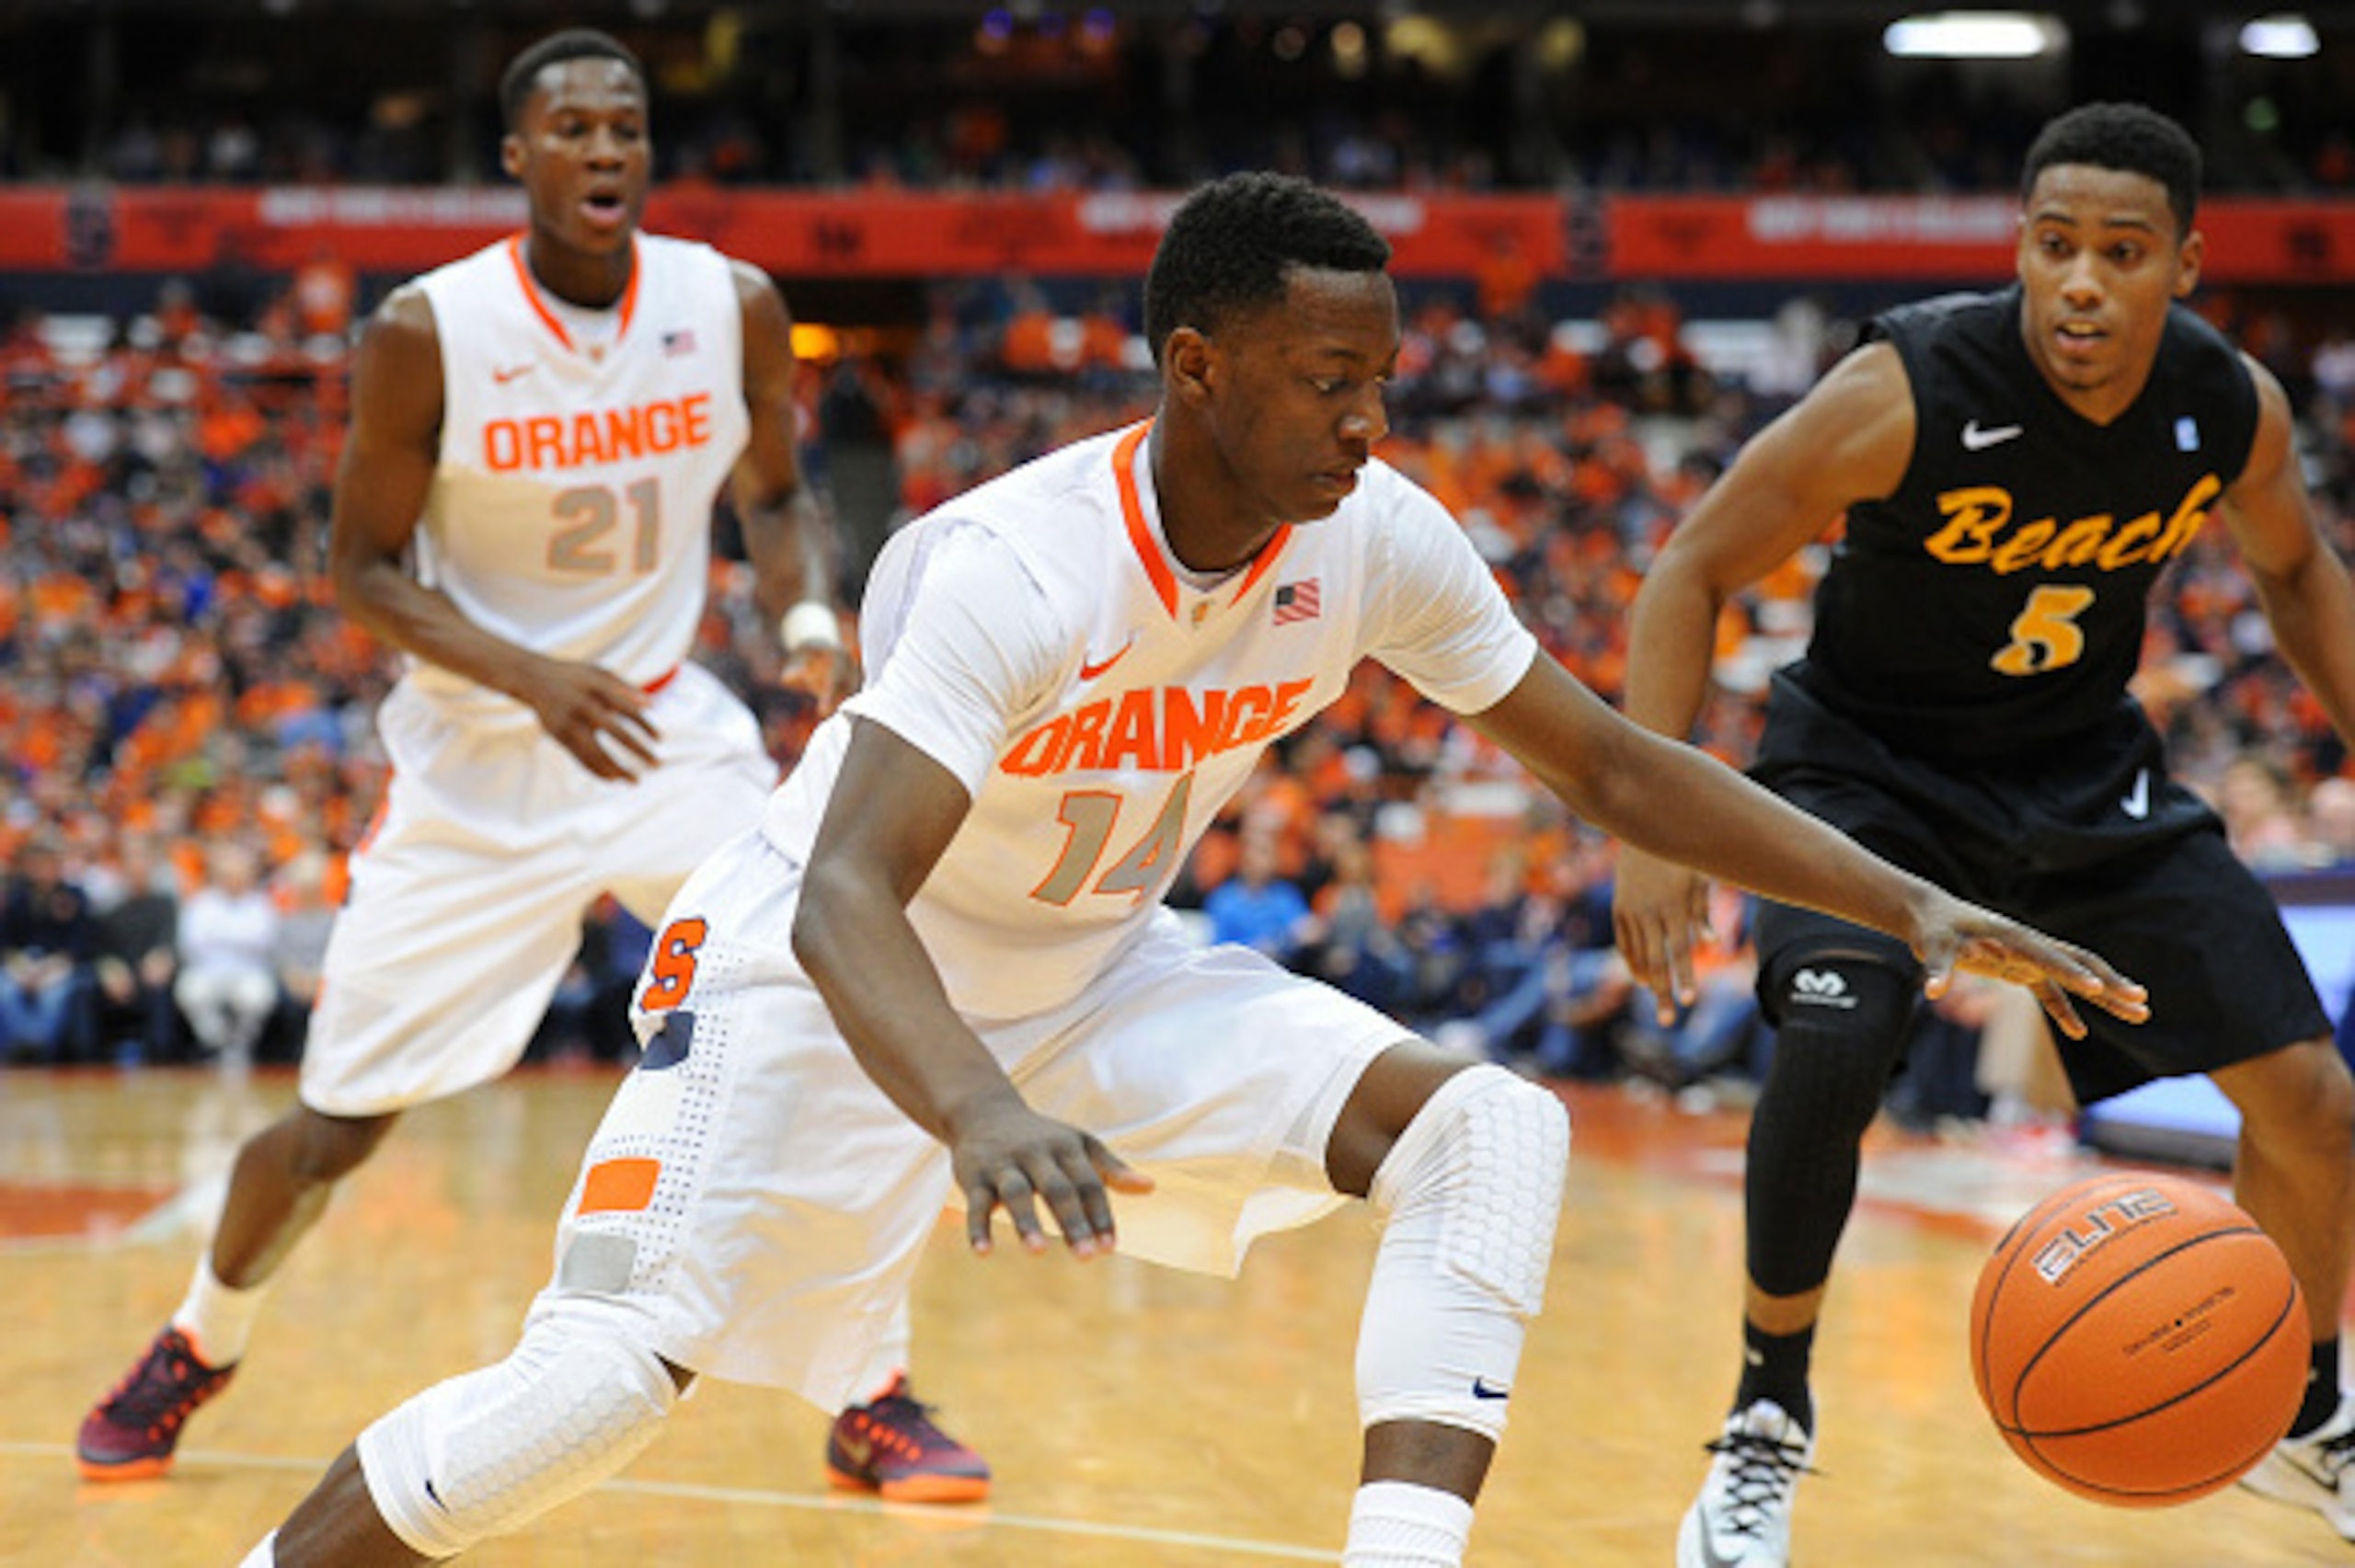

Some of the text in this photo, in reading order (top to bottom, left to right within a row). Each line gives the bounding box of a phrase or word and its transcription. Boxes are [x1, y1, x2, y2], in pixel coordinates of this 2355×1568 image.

[484, 393, 711, 472] ORANGE
[546, 477, 663, 573] 21
[1924, 474, 2222, 574] Beach
[1991, 585, 2096, 676] 5
[999, 677, 1315, 777] ORANGE
[1028, 770, 1196, 907] 14
[639, 917, 708, 1013] S
[2031, 1188, 2175, 1285] ELITE
